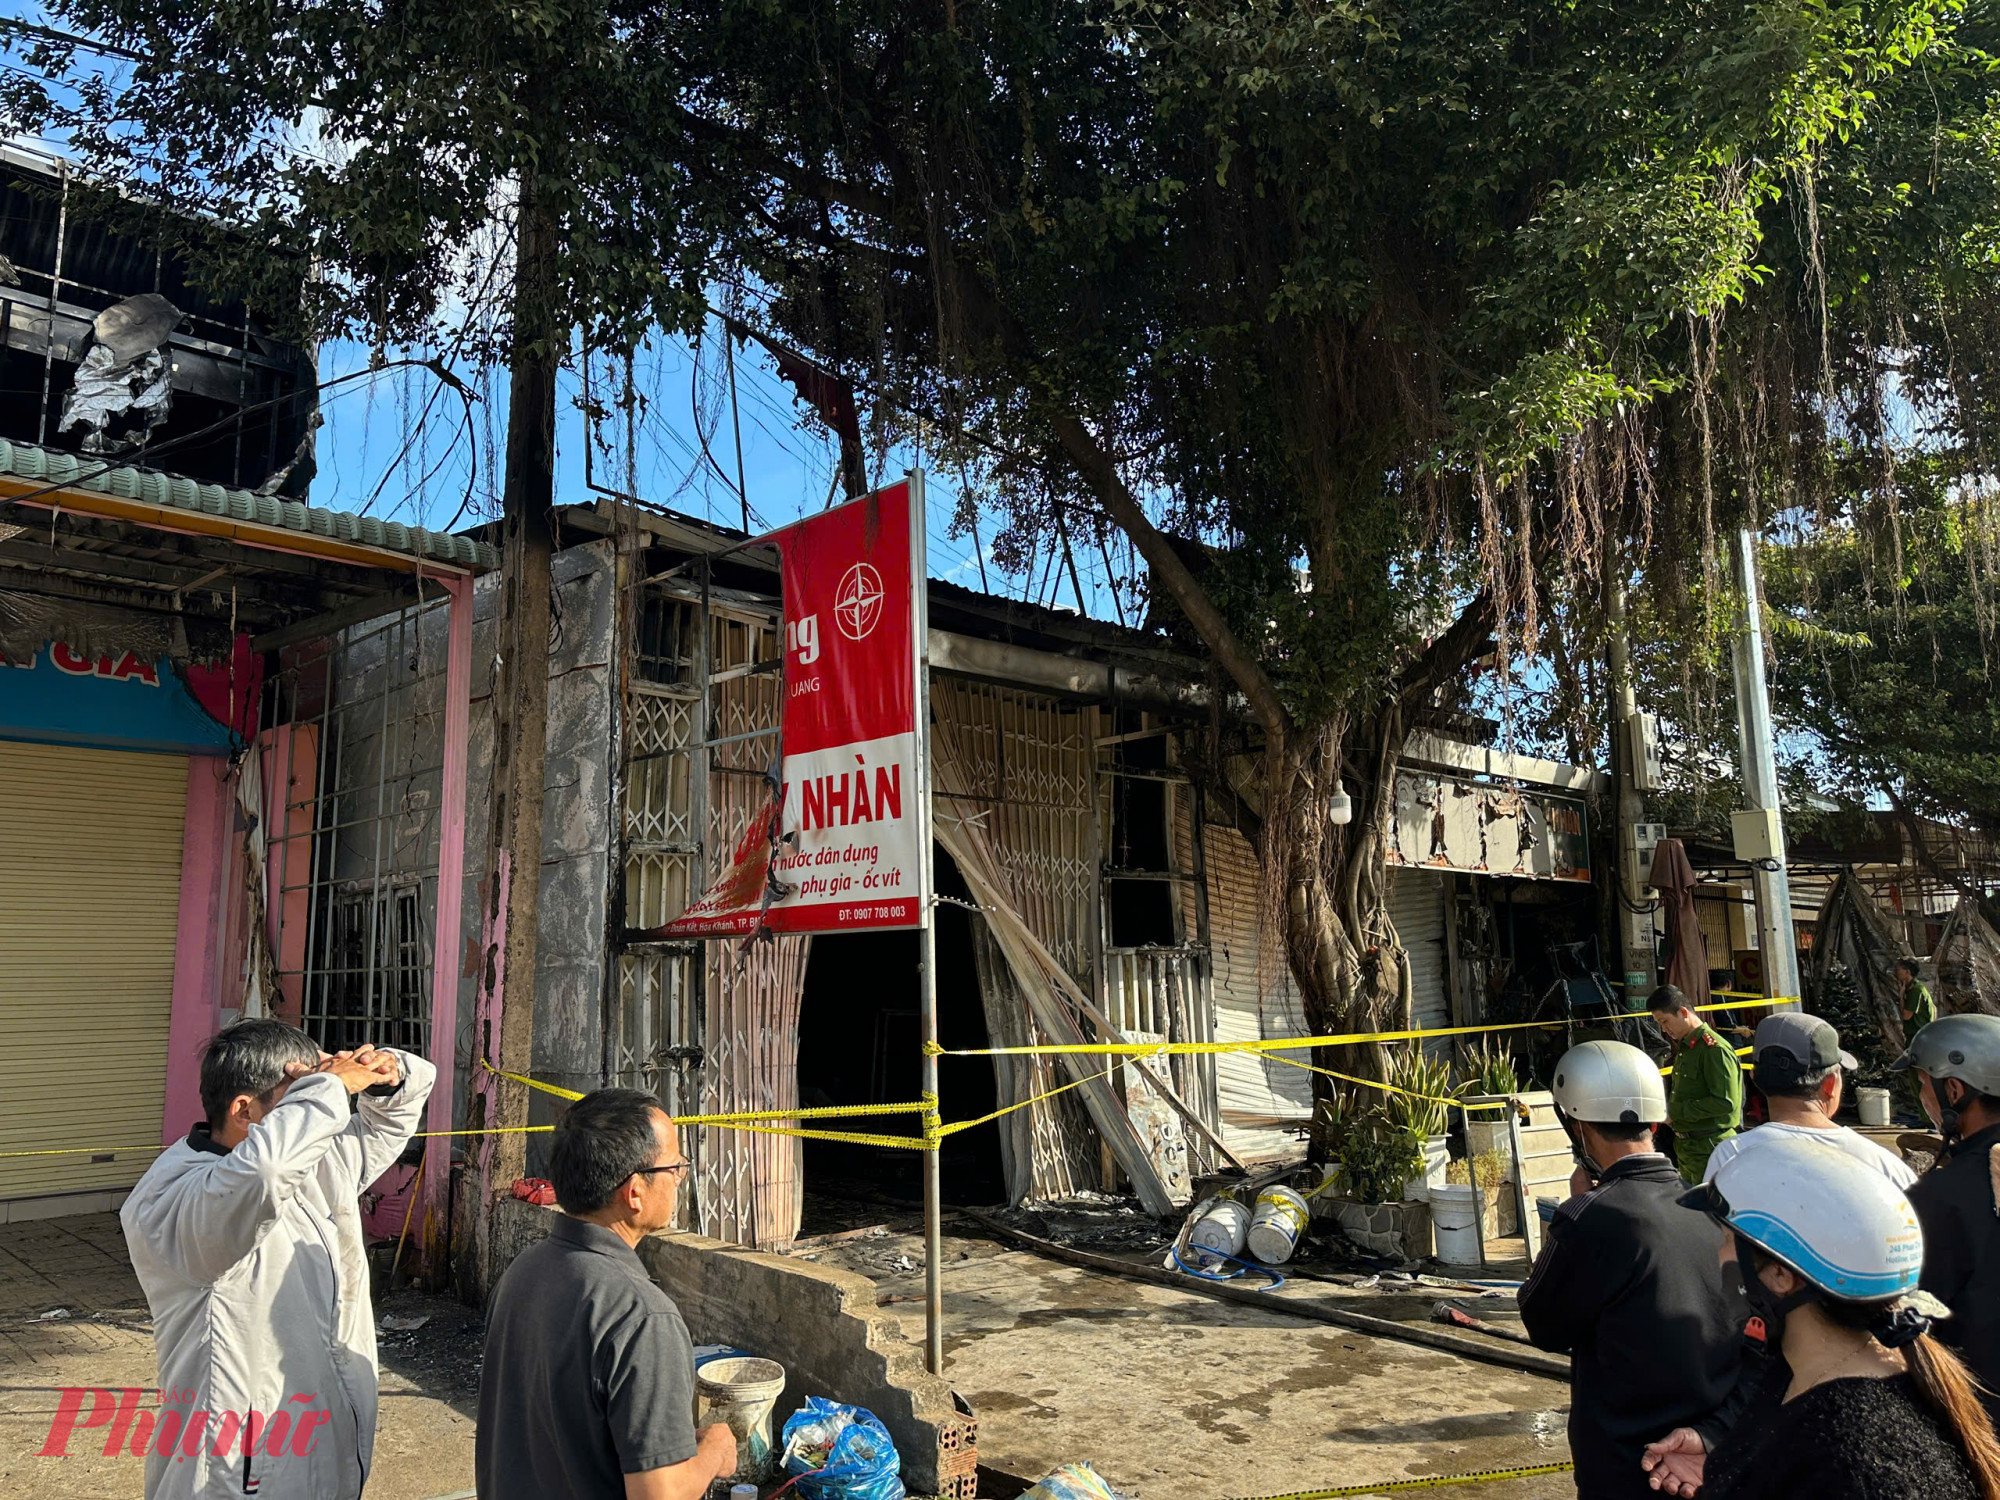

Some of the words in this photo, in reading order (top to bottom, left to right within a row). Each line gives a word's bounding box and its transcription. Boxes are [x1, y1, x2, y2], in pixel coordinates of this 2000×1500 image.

[802, 754, 902, 831] NHÀN
[779, 849, 812, 871] nước
[815, 844, 841, 866] dân
[843, 842, 878, 867] dụng
[800, 875, 826, 898] phụ
[829, 872, 851, 897] gia
[862, 866, 880, 889] ốc
[882, 866, 901, 888] vít
[737, 918, 748, 929] TP.
[839, 908, 852, 921] ĐT:
[853, 907, 873, 920] 0907
[874, 906, 889, 919] 708
[890, 905, 906, 918] 003
